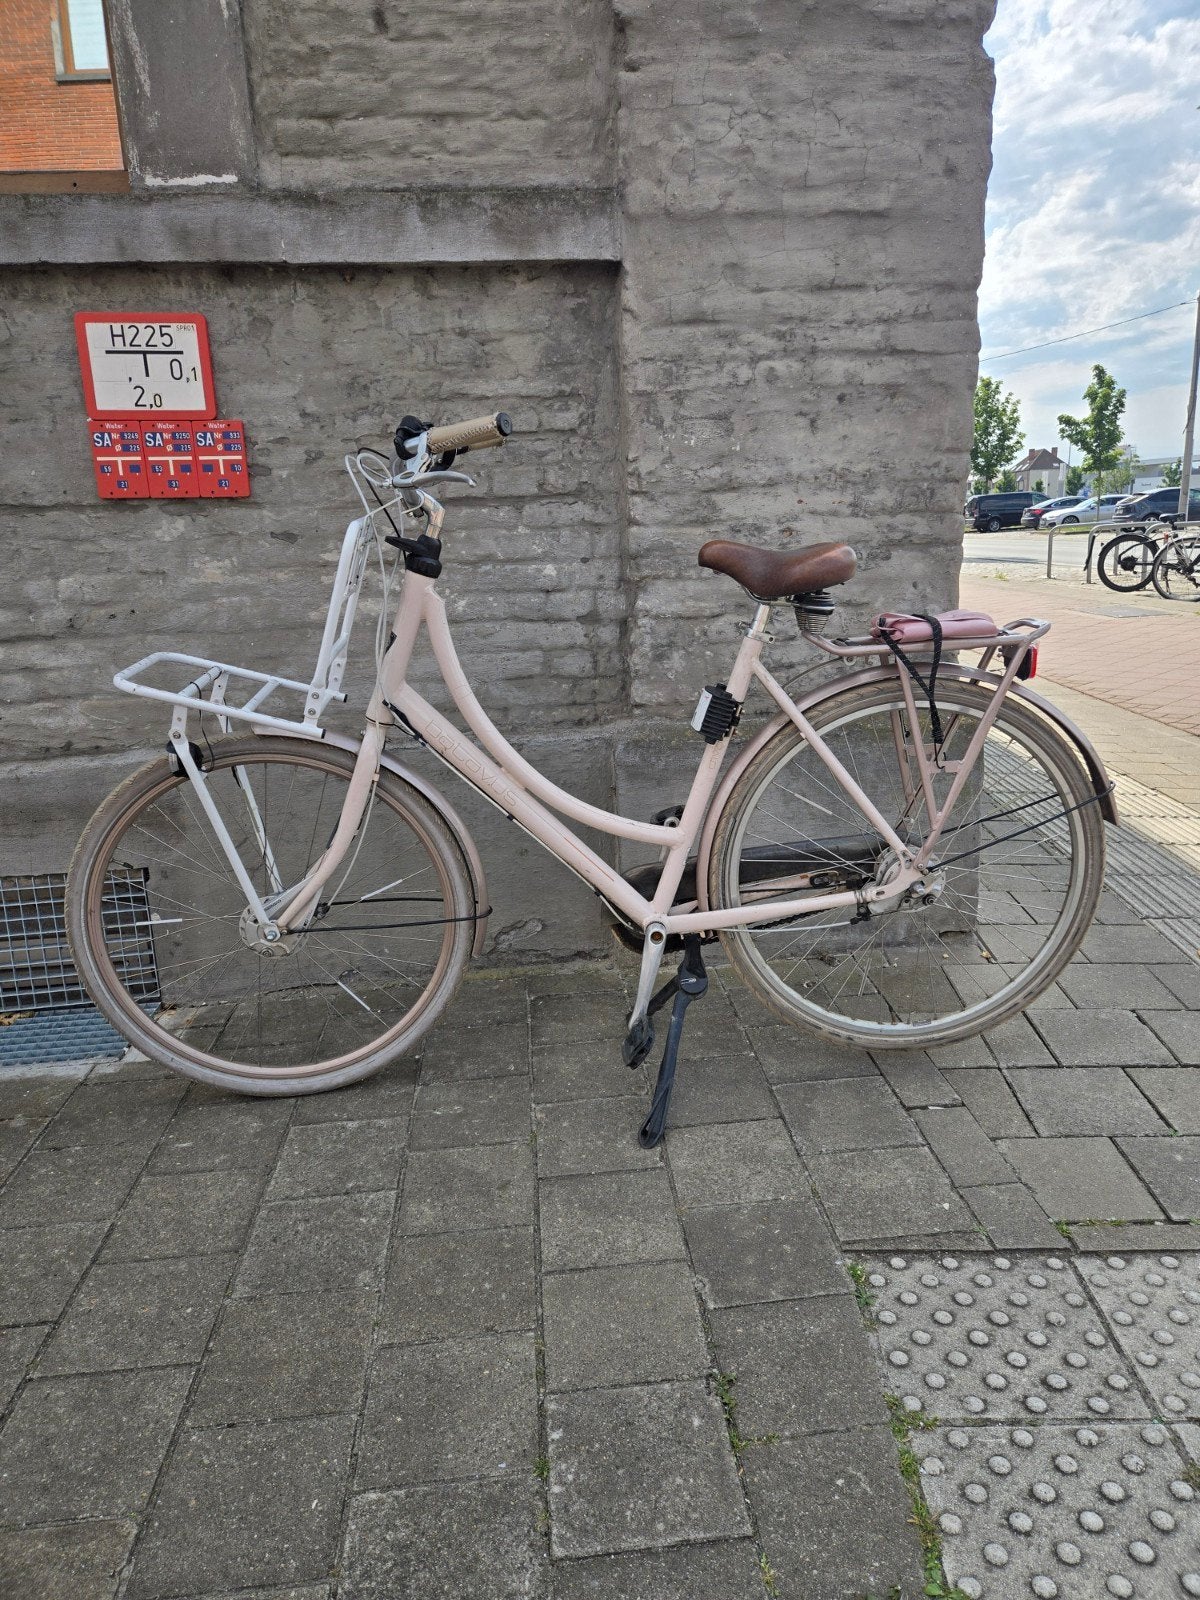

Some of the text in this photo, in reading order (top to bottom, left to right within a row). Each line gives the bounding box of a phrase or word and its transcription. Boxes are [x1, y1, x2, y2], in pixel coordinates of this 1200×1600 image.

[110, 325, 174, 347] H225
[133, 385, 163, 409] 2,0
[93, 432, 112, 447] SA
[145, 432, 164, 447] SA
[196, 432, 214, 446] SA
